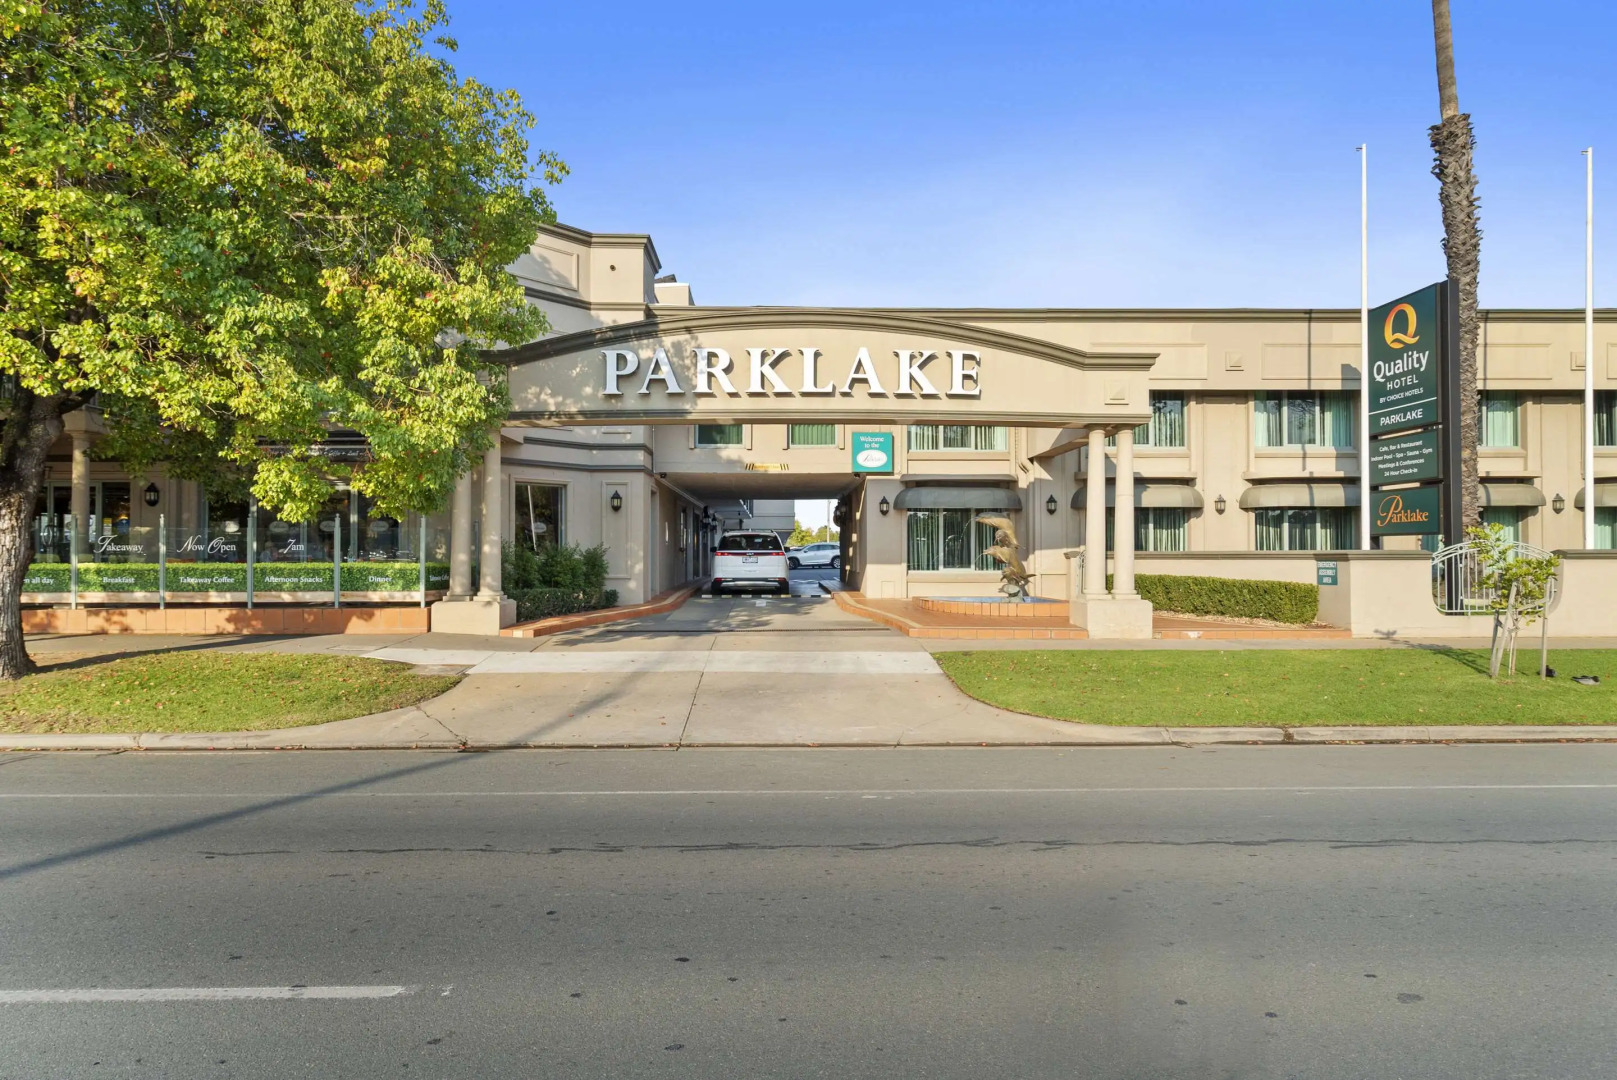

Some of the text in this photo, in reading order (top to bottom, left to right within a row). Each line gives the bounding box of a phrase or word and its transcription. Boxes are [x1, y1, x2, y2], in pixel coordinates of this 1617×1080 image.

[1384, 303, 1420, 349] Q
[601, 347, 982, 396] PARKLAKE
[1373, 350, 1429, 382] Quality
[1387, 374, 1419, 391] HOTEL
[1386, 392, 1404, 402] CHOICE
[1405, 387, 1424, 397] HOTELS
[1380, 408, 1423, 426] PARKLAKE
[1376, 495, 1429, 527] Parklake
[93, 534, 143, 554] Takeaway
[177, 535, 236, 554] Now Open
[280, 538, 305, 554] 7am
[41, 577, 54, 585] day
[102, 576, 136, 584] Breakfast
